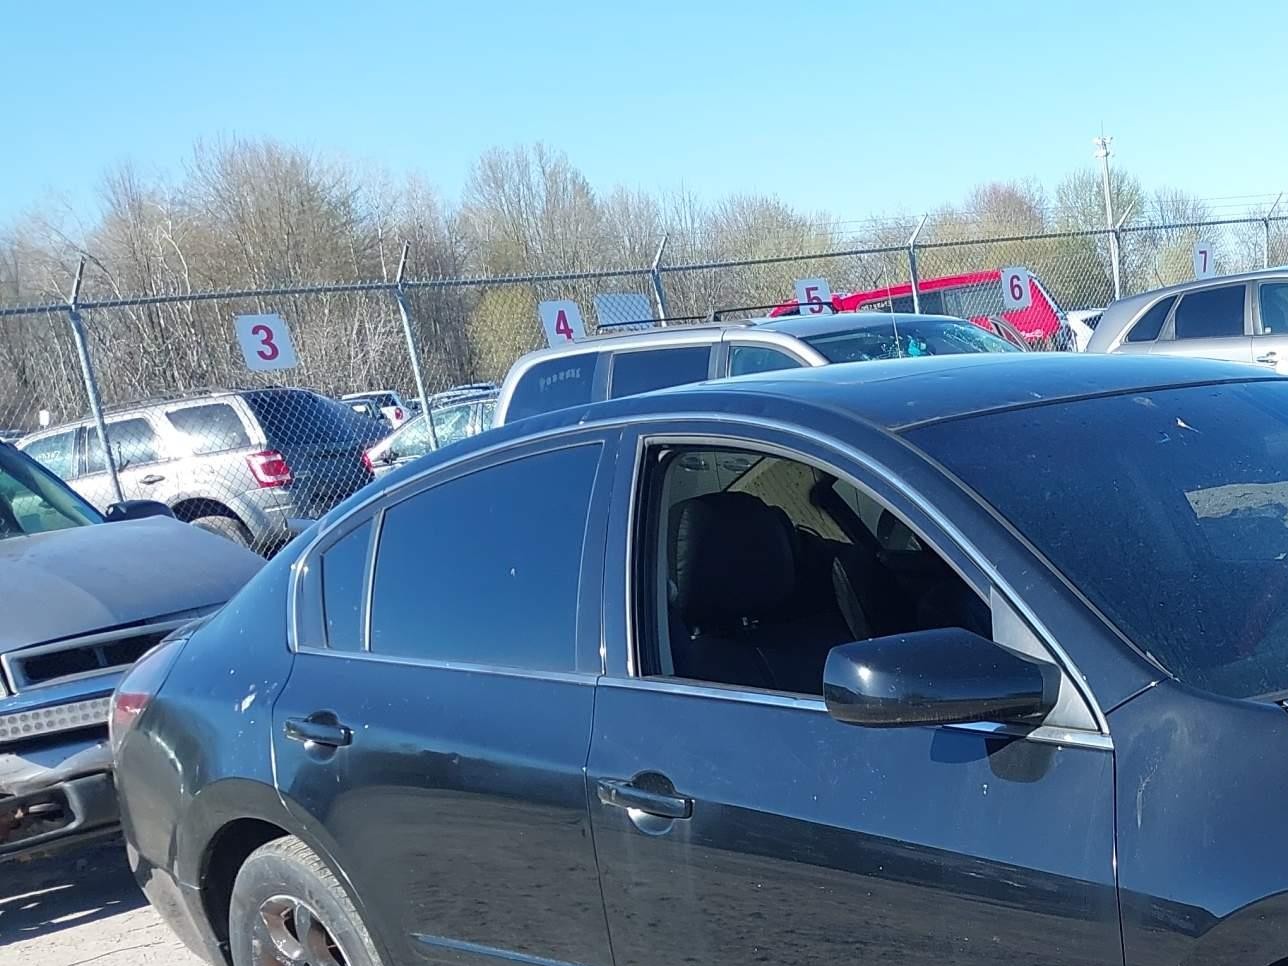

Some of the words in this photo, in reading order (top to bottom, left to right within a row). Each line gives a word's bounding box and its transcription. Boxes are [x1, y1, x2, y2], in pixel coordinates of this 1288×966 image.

[1198, 250, 1208, 273] 7
[805, 285, 824, 314] 5
[1009, 274, 1024, 301] 6
[555, 309, 574, 340] 4
[251, 324, 279, 361] 3
